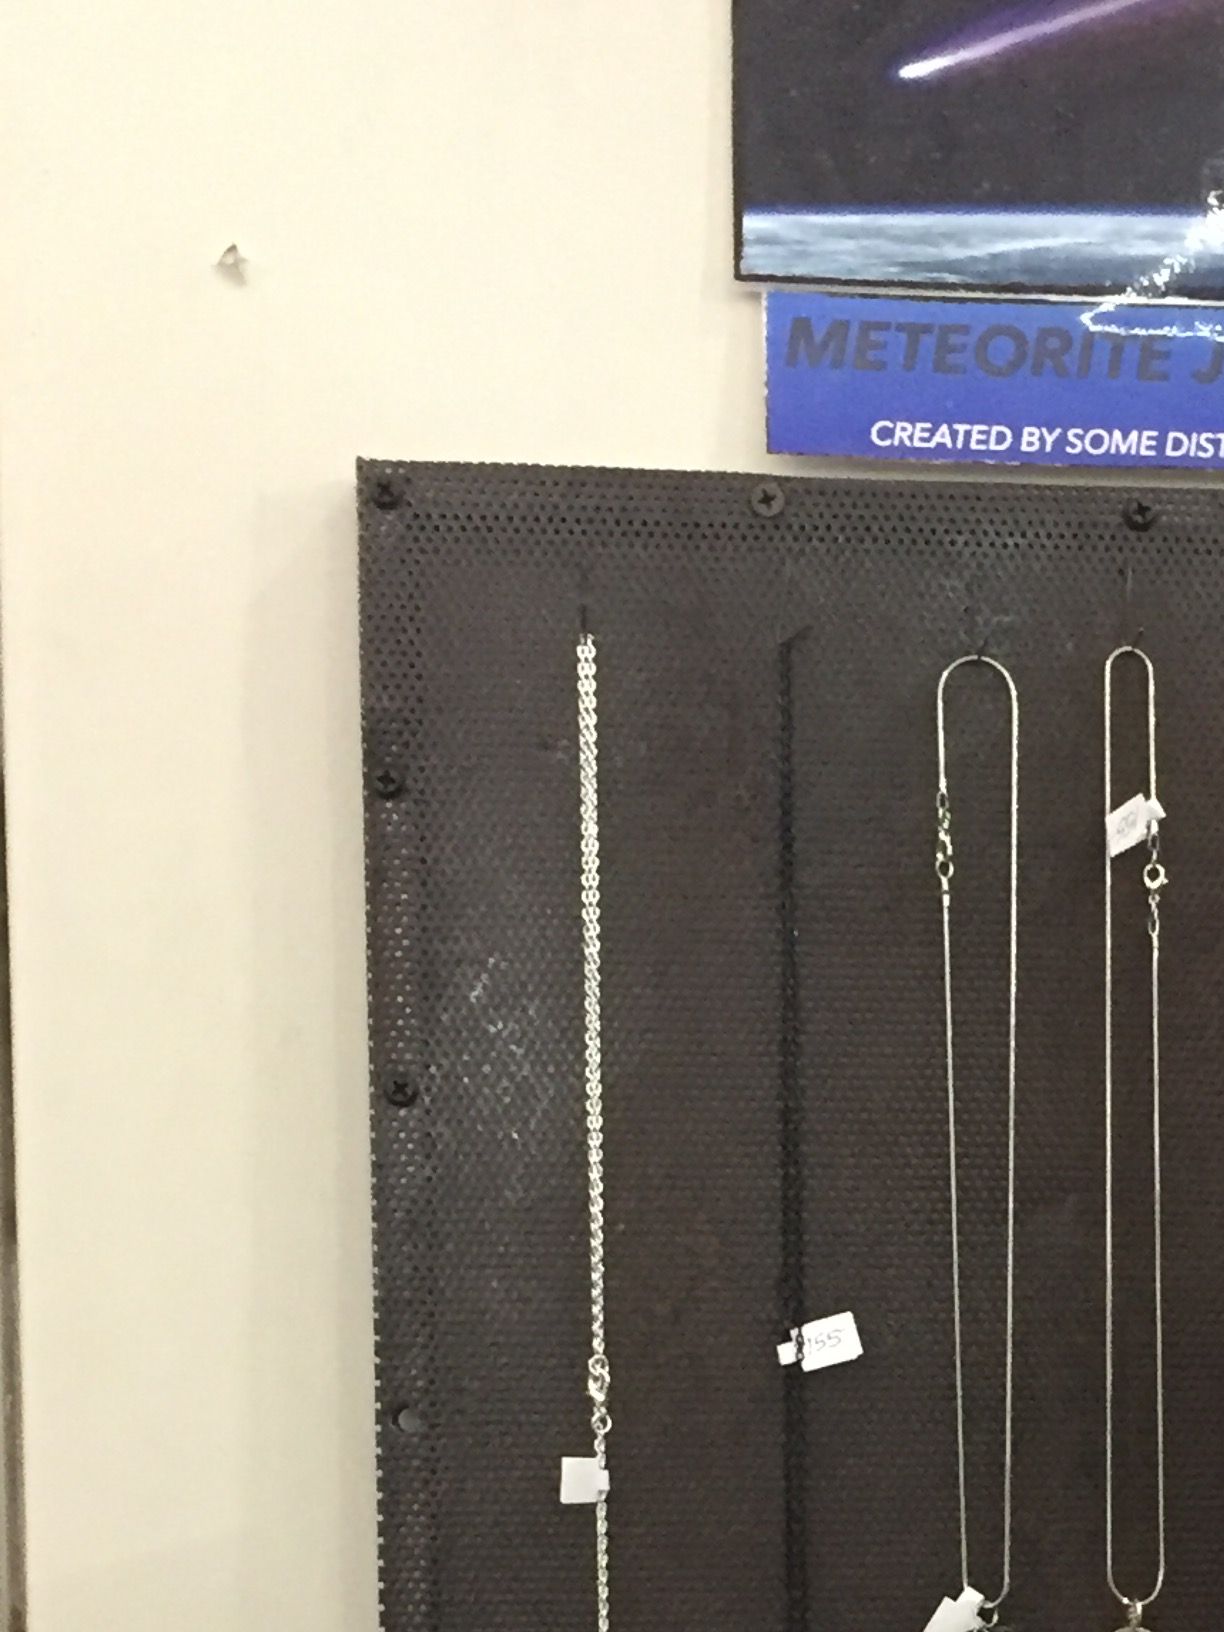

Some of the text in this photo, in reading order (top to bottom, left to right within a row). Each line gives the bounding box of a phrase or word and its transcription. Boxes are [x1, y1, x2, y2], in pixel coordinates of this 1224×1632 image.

[784, 317, 1171, 383] METEORITE
[870, 420, 1013, 450] CREATED
[1020, 426, 1061, 452] BY
[1065, 428, 1158, 456] SOME
